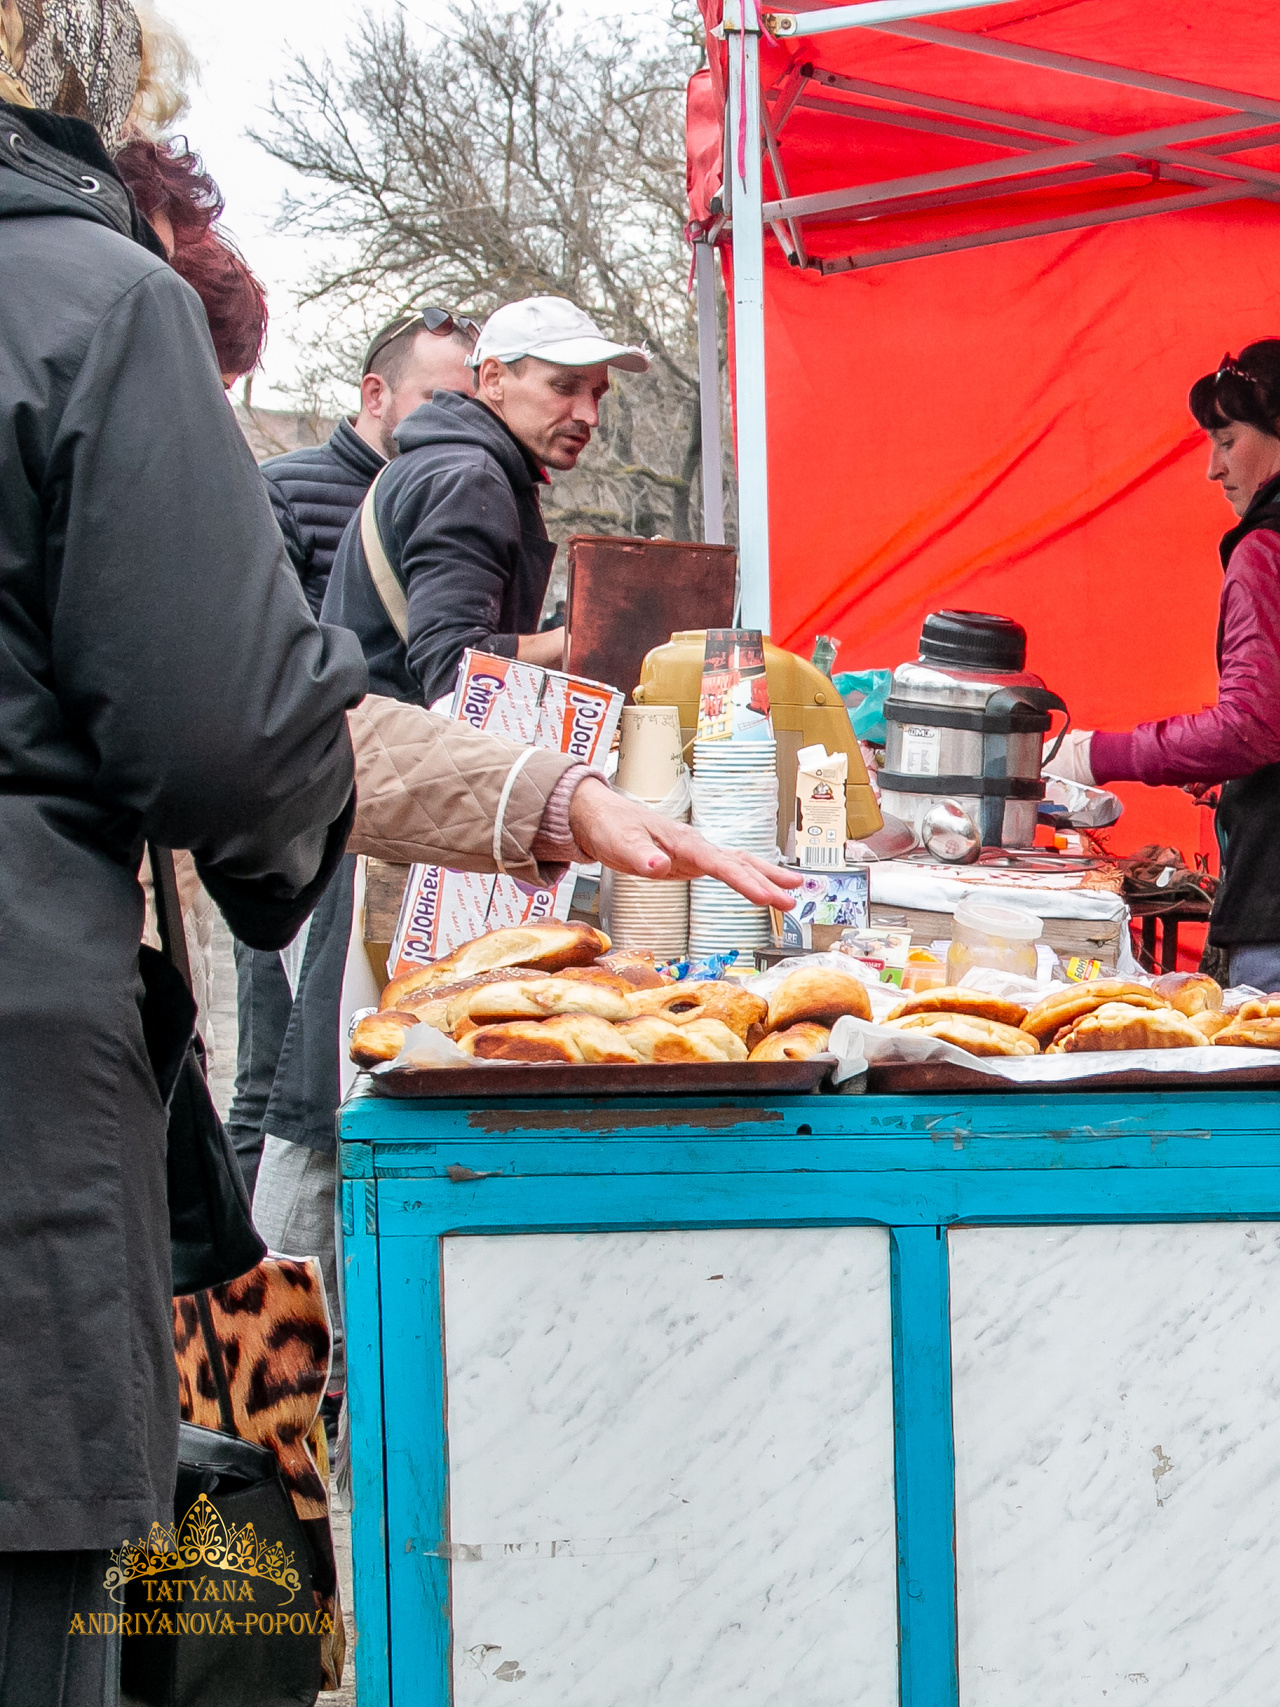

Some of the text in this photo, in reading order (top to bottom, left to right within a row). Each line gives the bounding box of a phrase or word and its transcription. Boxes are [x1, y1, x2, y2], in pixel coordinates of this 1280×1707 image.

[465, 673, 505, 729] Смач
[570, 696, 602, 757] ного!
[404, 865, 439, 963] мачного!
